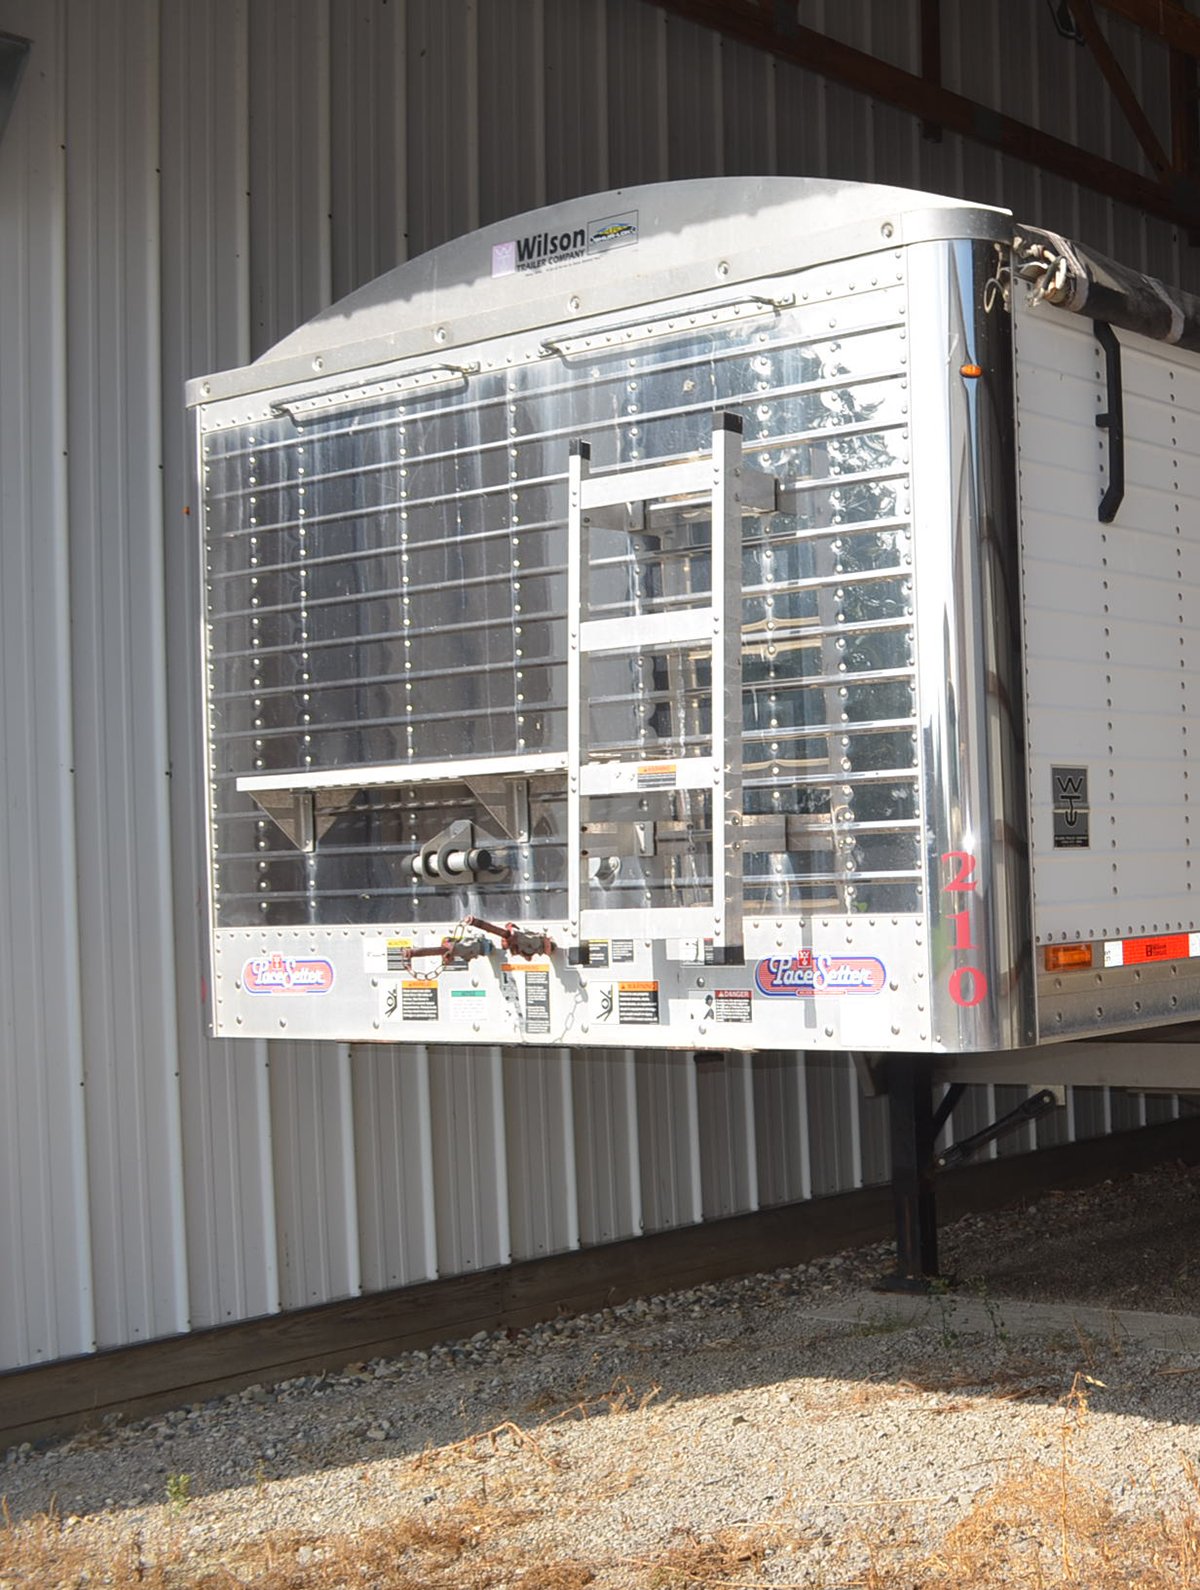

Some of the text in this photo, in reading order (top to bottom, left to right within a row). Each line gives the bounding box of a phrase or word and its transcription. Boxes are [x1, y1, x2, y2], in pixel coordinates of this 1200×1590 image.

[516, 228, 586, 262] Wilson
[516, 258, 546, 272] TRAILER
[548, 249, 585, 265] COMPANY
